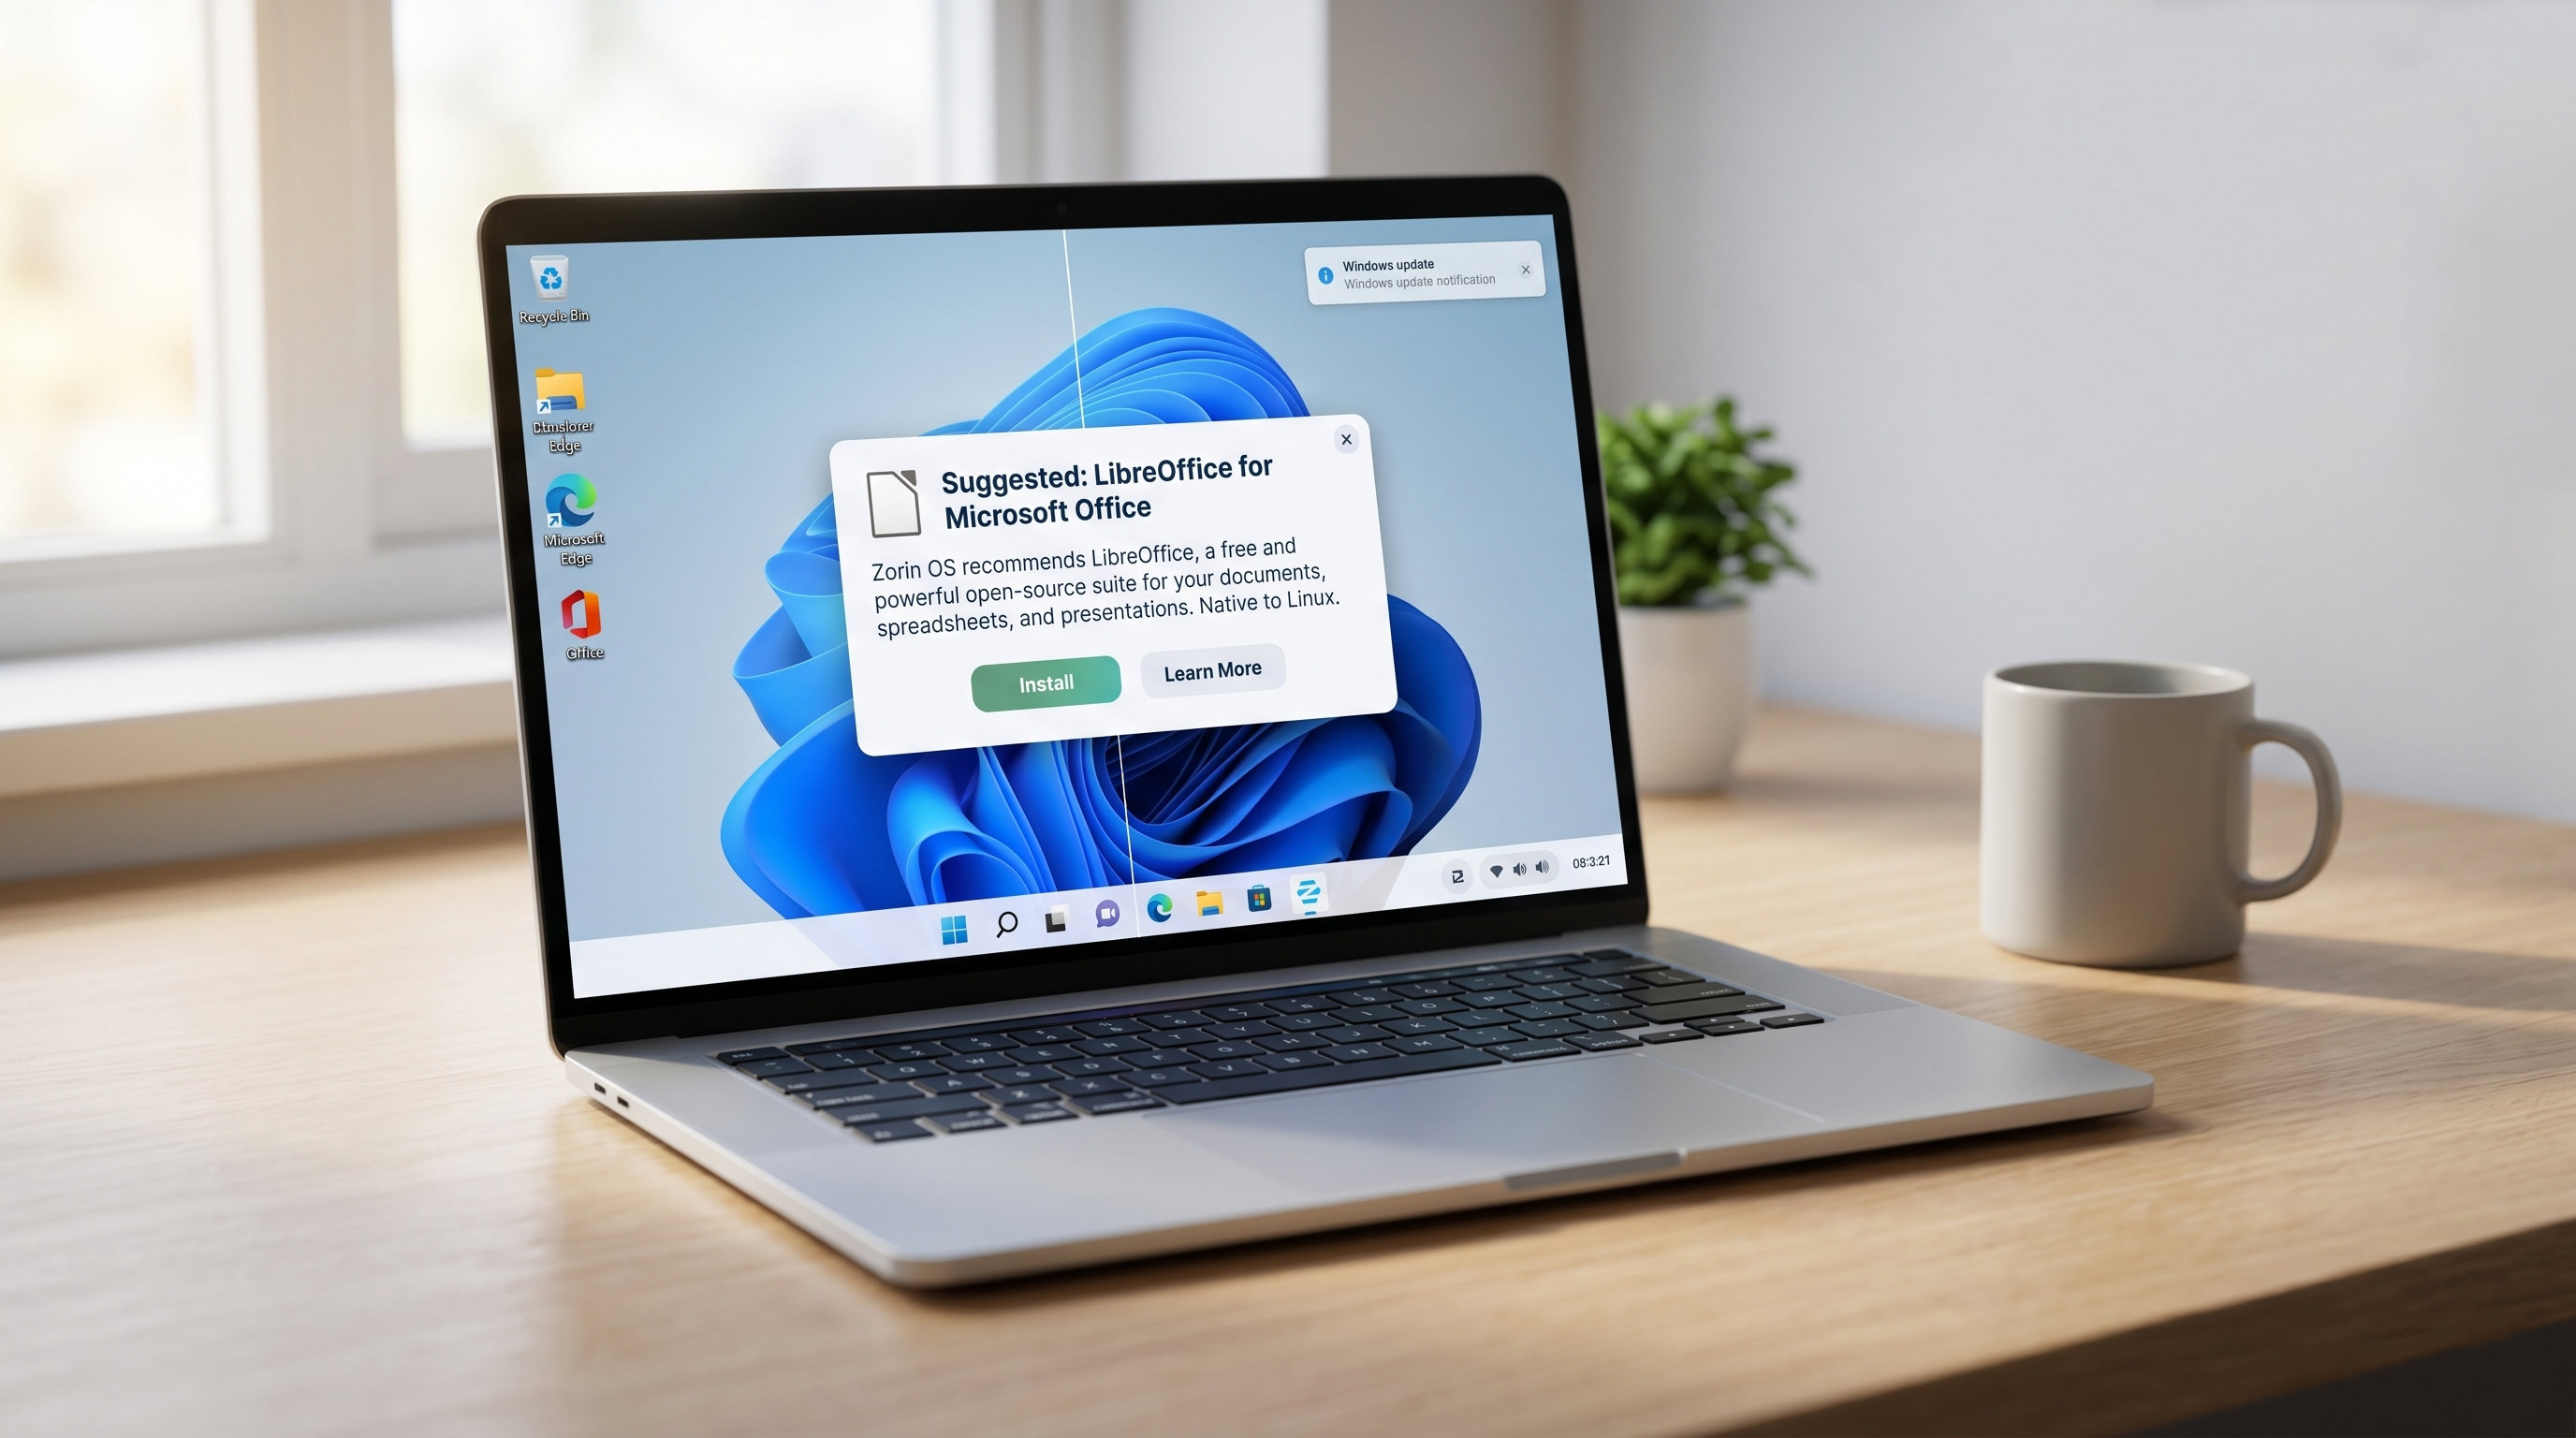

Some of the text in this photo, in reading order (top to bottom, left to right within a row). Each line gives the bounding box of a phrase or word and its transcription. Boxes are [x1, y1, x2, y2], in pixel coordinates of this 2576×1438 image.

[1342, 258, 1435, 272] Windows update
[1344, 273, 1496, 290] Windows update notification
[520, 309, 590, 327] Recycle Bin
[549, 437, 581, 455] Edge
[942, 454, 1274, 499] Suggested: LibreOffice for
[944, 495, 1151, 530] Microsoft Office
[544, 532, 606, 548] Microsoft
[561, 552, 593, 567] Edge
[871, 536, 1296, 581] Zorin OS recommends LibreOffice, a free and
[874, 564, 1325, 614] powerful open-source suite for your documents,
[877, 590, 1339, 641] spreadsheets, and presentations. Native to Linux.
[1164, 661, 1263, 682] Learn More
[1019, 673, 1075, 694] Install
